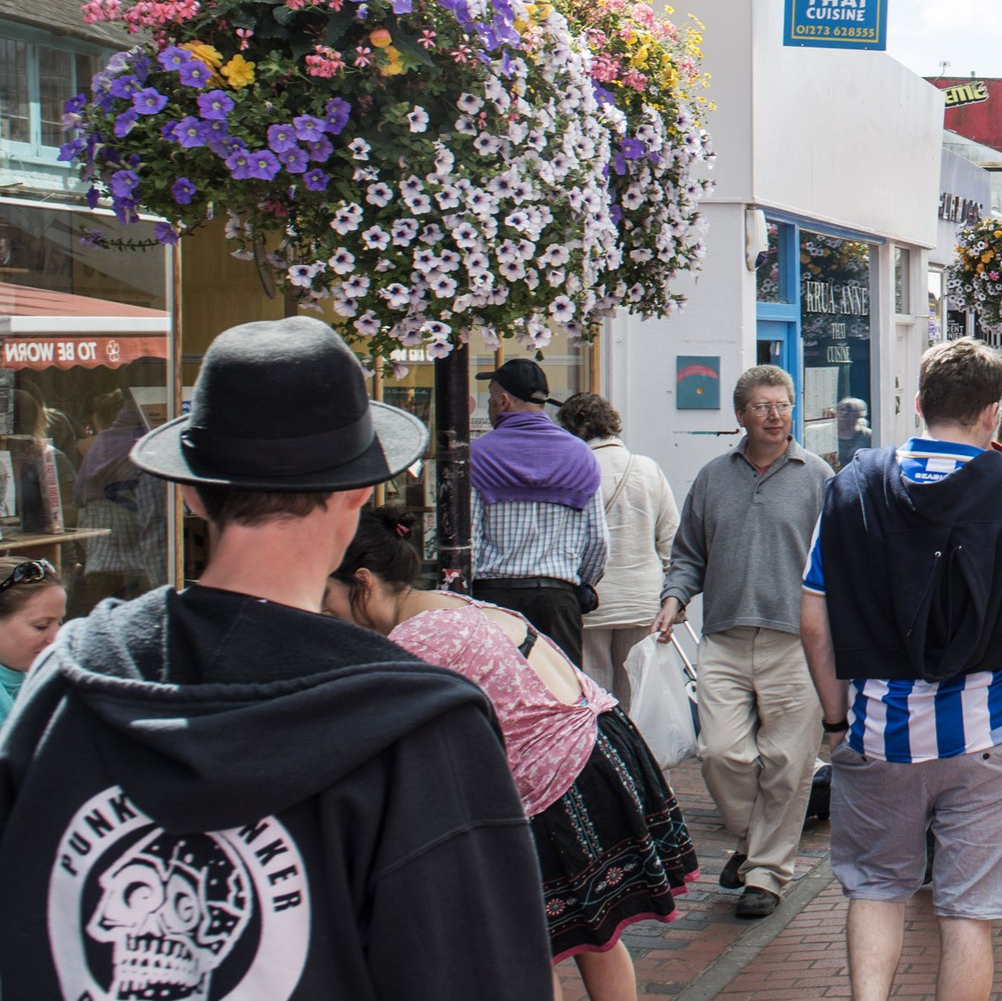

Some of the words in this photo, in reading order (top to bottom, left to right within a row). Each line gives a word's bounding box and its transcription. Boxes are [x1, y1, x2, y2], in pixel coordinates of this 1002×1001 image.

[805, 7, 866, 22] CUISINE
[796, 24, 831, 36] 01273
[833, 26, 875, 38] 628555
[805, 280, 837, 315] KRUA
[840, 285, 869, 316] ANNE
[831, 322, 847, 340] THAI
[826, 345, 851, 363] CUISINE
[60, 793, 138, 878] PUNK
[238, 821, 303, 913] NKER
